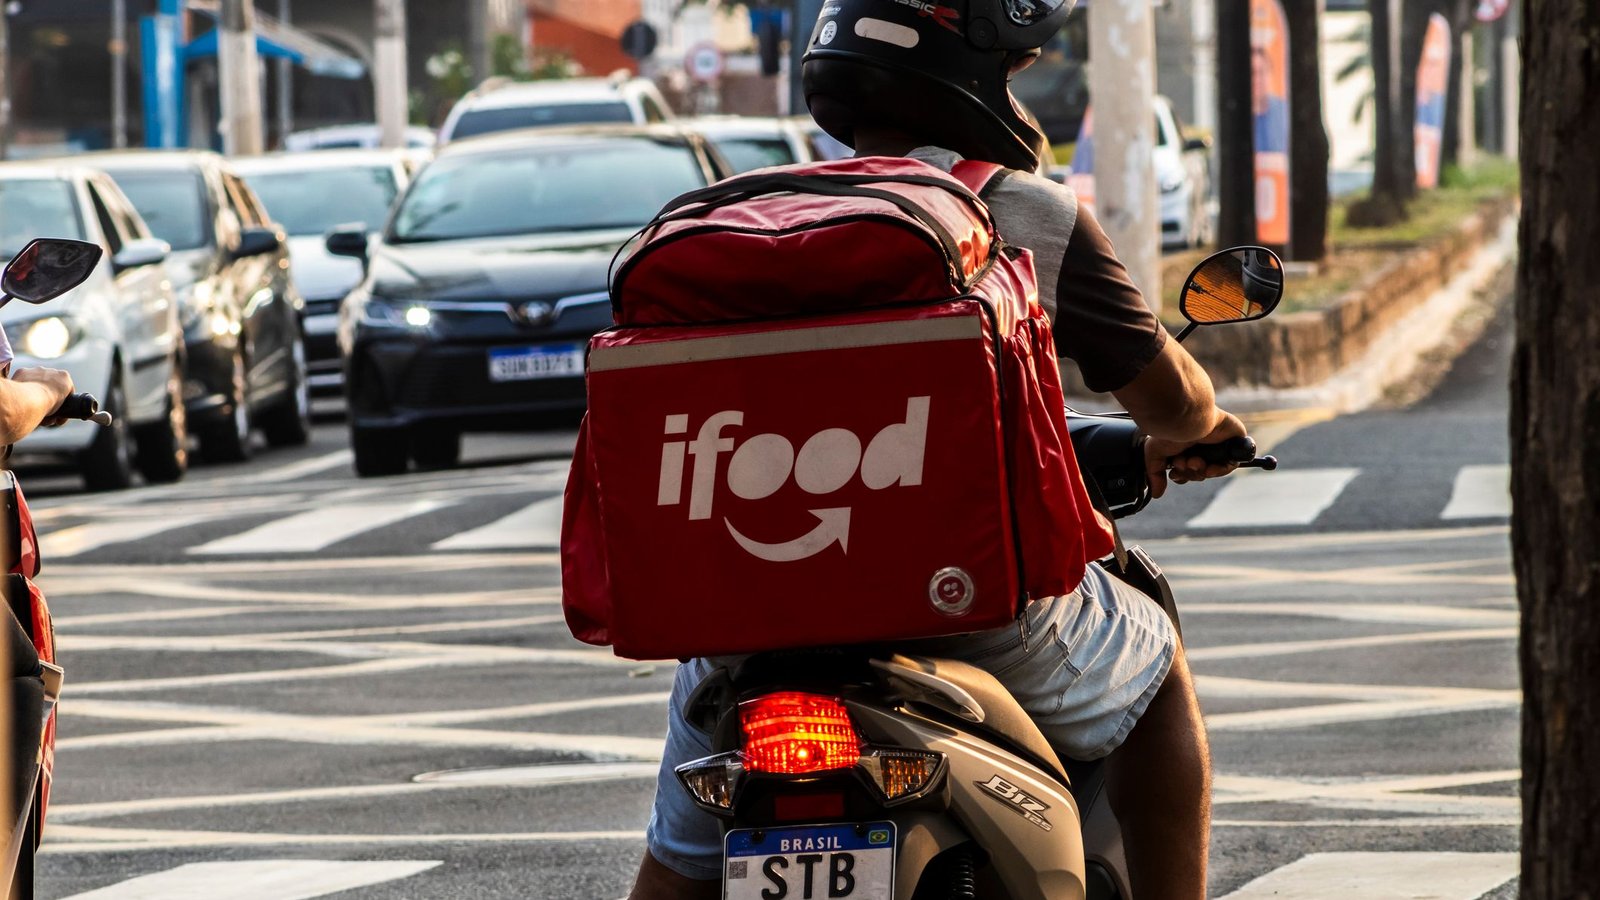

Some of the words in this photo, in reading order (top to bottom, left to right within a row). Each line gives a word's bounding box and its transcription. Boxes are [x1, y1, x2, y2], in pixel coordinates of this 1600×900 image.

[657, 395, 931, 520] ifood
[1024, 811, 1052, 831] 125
[780, 836, 842, 851] BRASIL
[761, 852, 855, 900] STB
